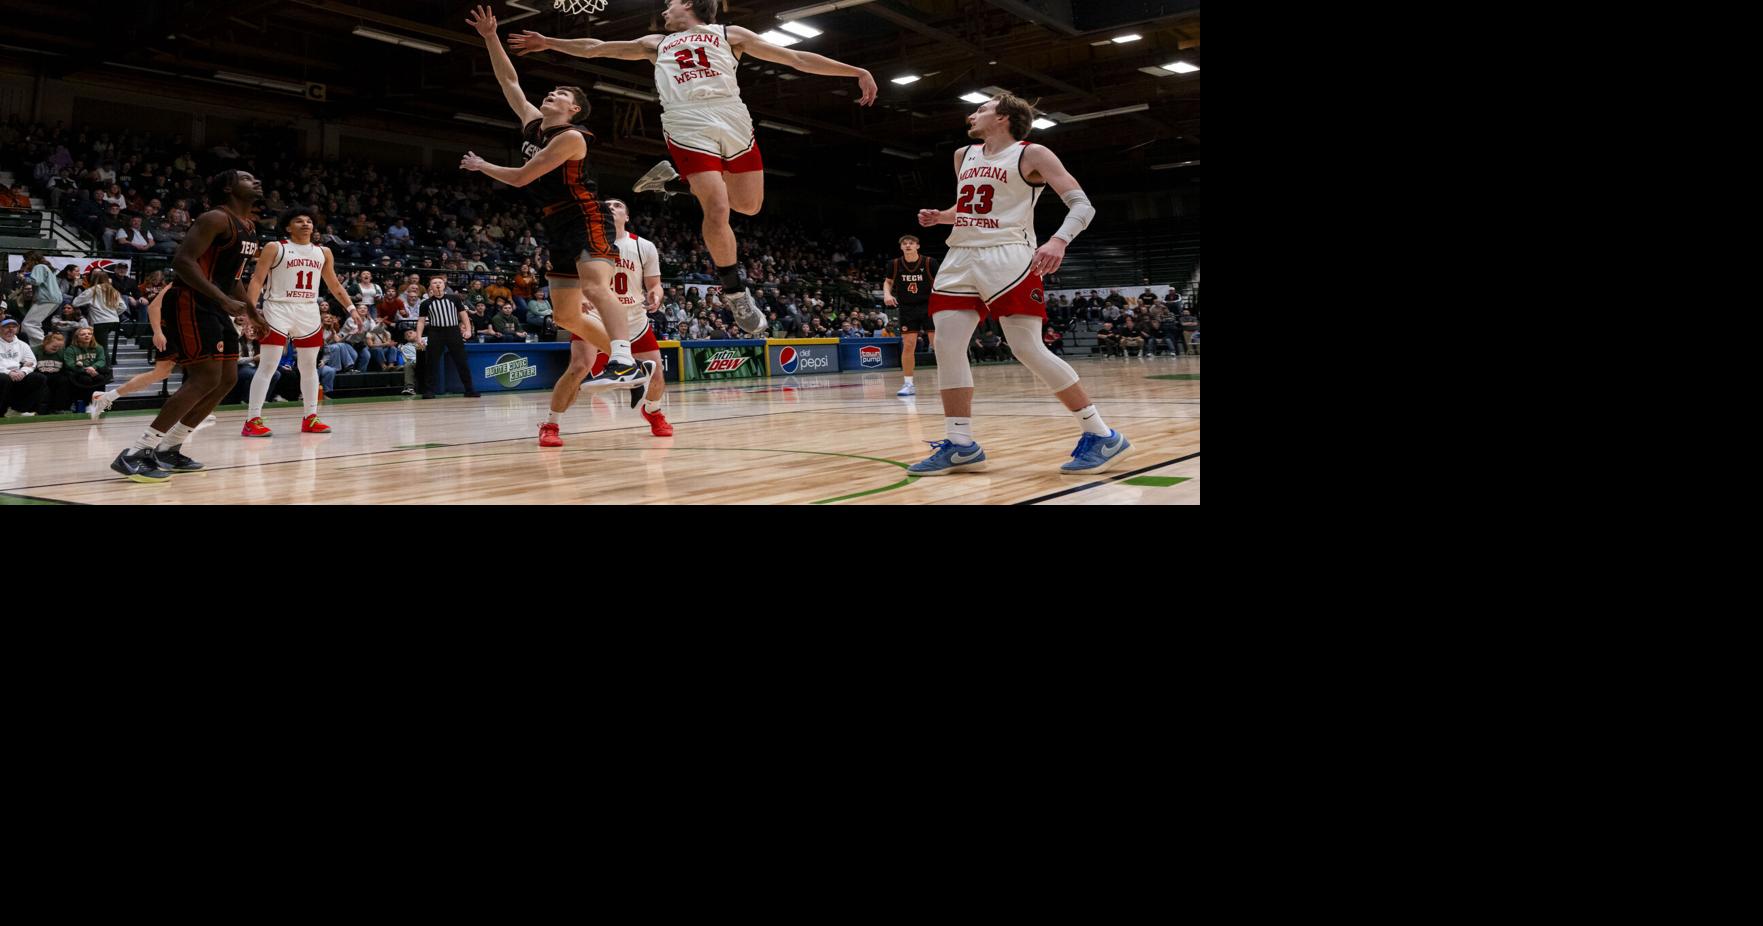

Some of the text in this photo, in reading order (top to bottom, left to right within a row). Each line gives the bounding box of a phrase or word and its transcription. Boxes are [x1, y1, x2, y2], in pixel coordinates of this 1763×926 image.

[663, 34, 720, 53] MONTANA
[674, 47, 711, 69] 21
[673, 69, 722, 84] WESTER
[960, 166, 1007, 183] MONTANA
[956, 184, 995, 214] 23
[955, 217, 999, 228] ESTERN
[295, 270, 313, 290] 11
[610, 272, 628, 295] 0
[901, 274, 923, 282] TECH
[907, 282, 919, 294] 4
[509, 359, 528, 371] CIVIC
[800, 355, 829, 370] pepsi
[510, 367, 536, 380] CENTER
